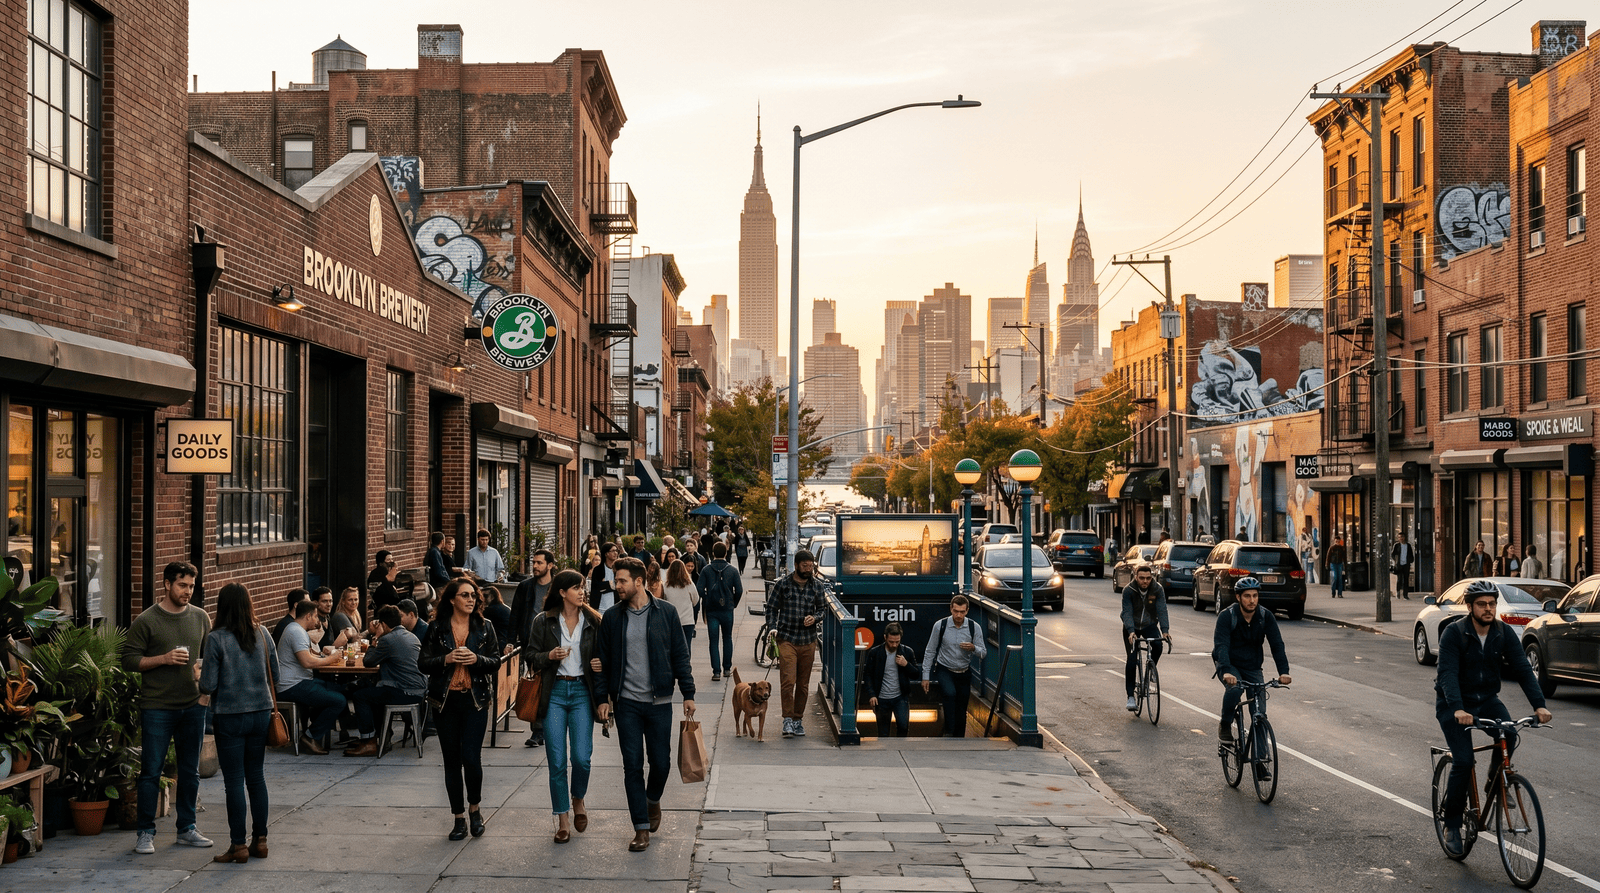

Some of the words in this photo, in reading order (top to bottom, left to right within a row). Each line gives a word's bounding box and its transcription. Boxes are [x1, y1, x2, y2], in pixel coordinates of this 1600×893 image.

[304, 246, 376, 314] BROOKLYN
[380, 283, 430, 335] BREWERY
[489, 297, 550, 319] BROOKLYN
[490, 346, 548, 368] BREWERY
[1484, 422, 1511, 430] MABO
[1526, 419, 1551, 436] SPOKE
[1552, 419, 1559, 434] &
[1560, 416, 1584, 433] WEAL
[178, 434, 222, 445] DAILY
[1482, 430, 1513, 438] GOODS
[172, 448, 228, 459] GOODS
[854, 605, 865, 621] L
[873, 605, 916, 621] train
[857, 631, 869, 646] L
